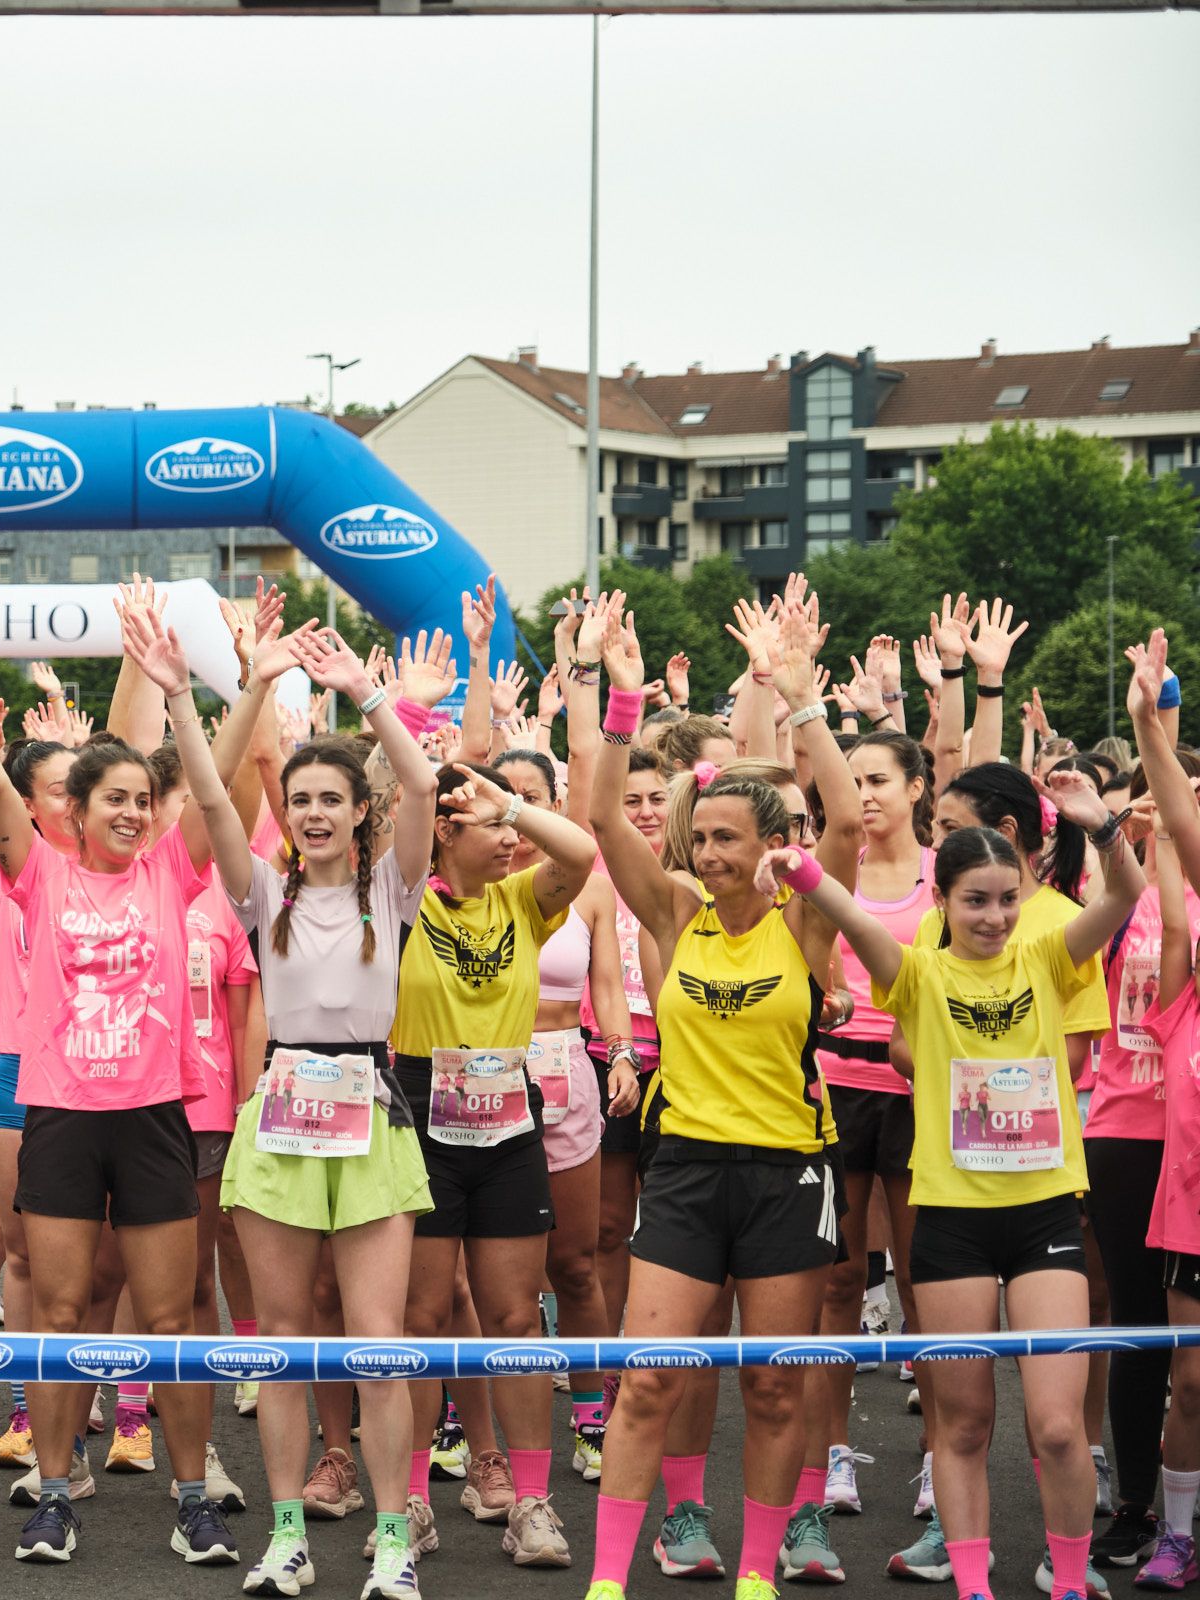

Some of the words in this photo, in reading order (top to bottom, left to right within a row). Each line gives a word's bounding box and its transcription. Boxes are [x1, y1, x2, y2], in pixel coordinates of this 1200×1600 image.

[155, 457, 255, 480] ASTURIANA
[330, 524, 430, 546] ASTURIANA
[461, 963, 496, 974] RUN
[711, 981, 740, 990] BORN
[710, 999, 739, 1009] RUN
[978, 1002, 1006, 1012] BORN
[980, 1020, 1008, 1031] RUN
[65, 1028, 140, 1059] MUJER
[88, 1063, 118, 1078] 2026
[298, 1067, 340, 1078] ASTURIANA
[292, 1098, 335, 1118] 016
[467, 1094, 503, 1111] 016
[991, 1110, 1033, 1130] 016
[271, 1126, 294, 1134] CARRERA
[440, 1131, 475, 1140] OYSHO
[1006, 1133, 1023, 1141] 608
[266, 1138, 300, 1148] OYSHO
[969, 1142, 996, 1150] CARRERA
[965, 1156, 1004, 1164] OYSHO
[74, 1351, 143, 1366] ASTURIANA
[212, 1353, 282, 1368] ASTURIANA
[351, 1355, 420, 1370] ASTURIANA
[491, 1356, 562, 1369] ASTURIANA
[633, 1356, 704, 1367] ASTURIANA
